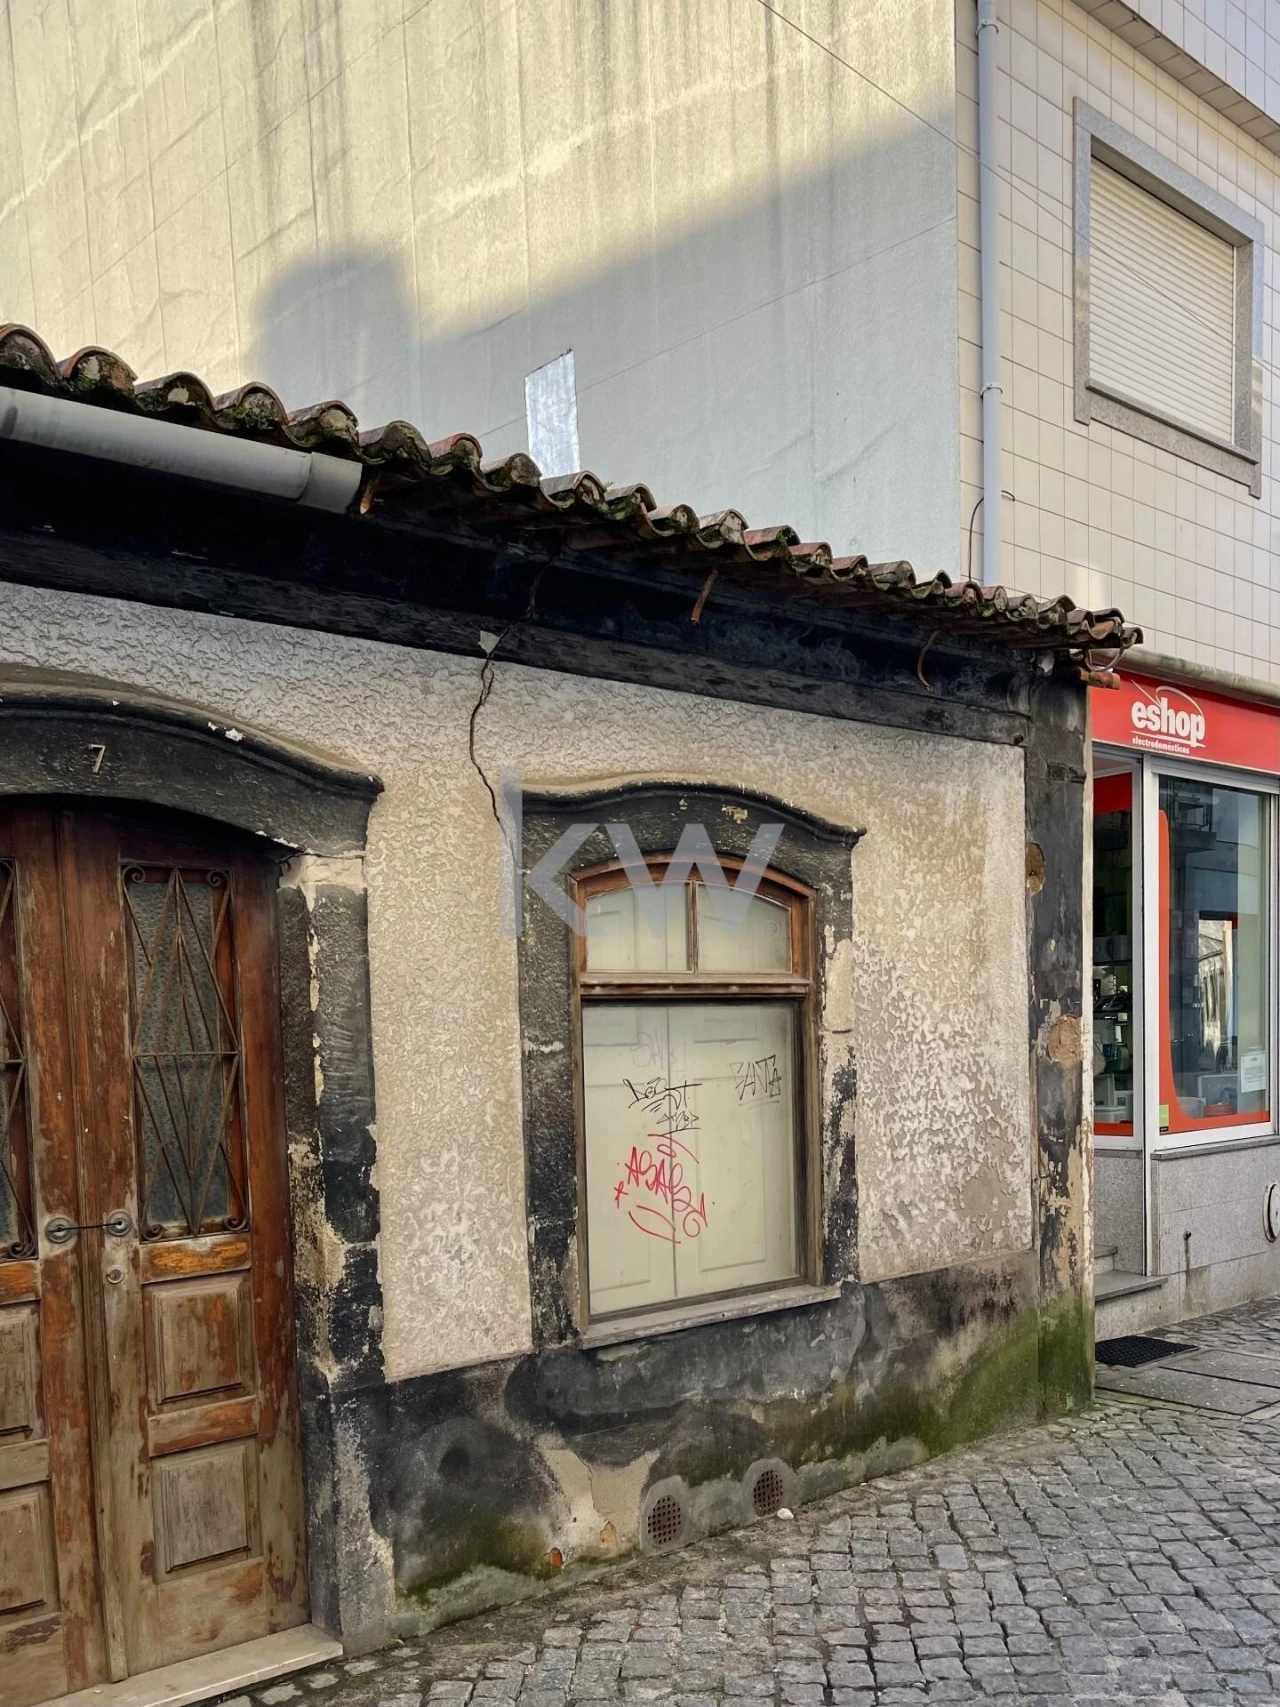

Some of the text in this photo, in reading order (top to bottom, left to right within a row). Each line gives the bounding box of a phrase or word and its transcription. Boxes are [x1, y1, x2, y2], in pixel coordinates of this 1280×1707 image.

[1131, 697, 1206, 747] eshop
[88, 744, 106, 773] 7
[1132, 735, 1190, 755] electrodomésticos
